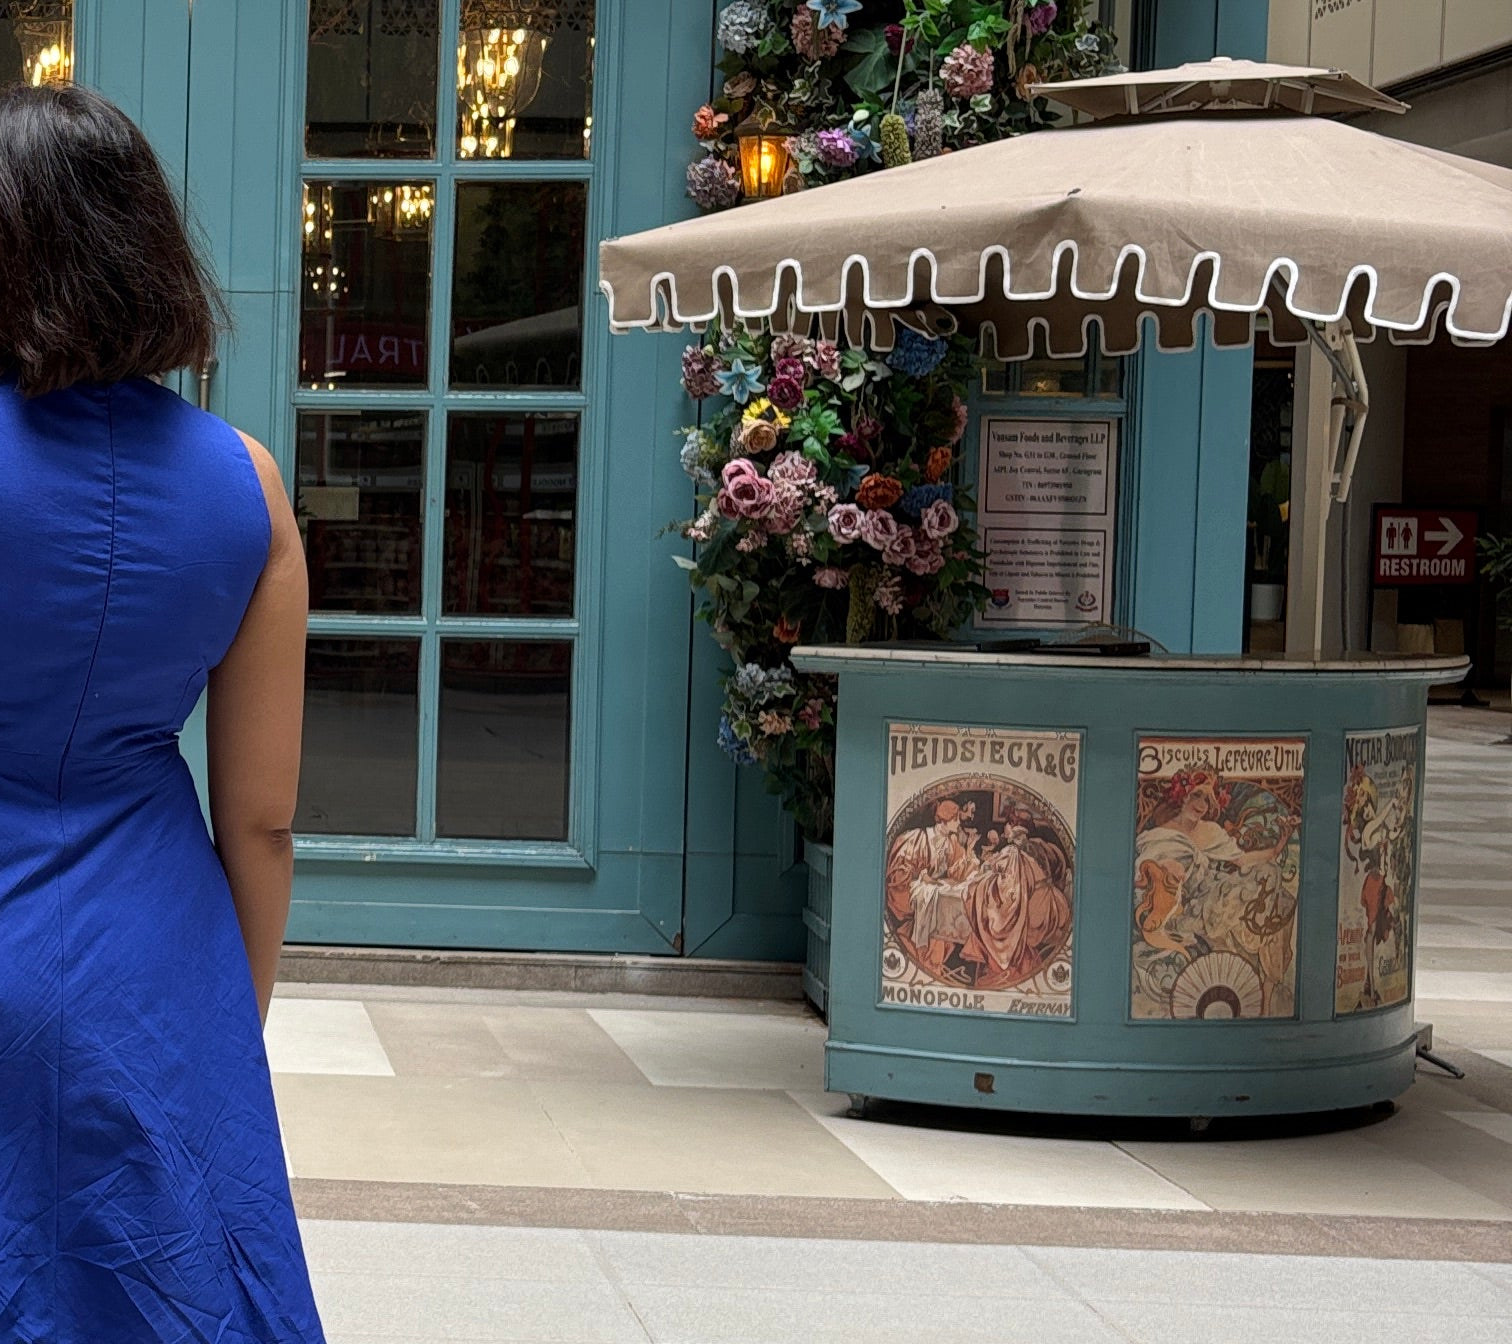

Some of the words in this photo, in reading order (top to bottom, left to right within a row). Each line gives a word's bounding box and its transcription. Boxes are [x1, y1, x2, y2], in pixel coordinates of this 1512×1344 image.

[1379, 558, 1466, 577] RESTROOM
[890, 735, 1044, 776] HEIDSIECK
[881, 985, 985, 1011] MONOPOLE
